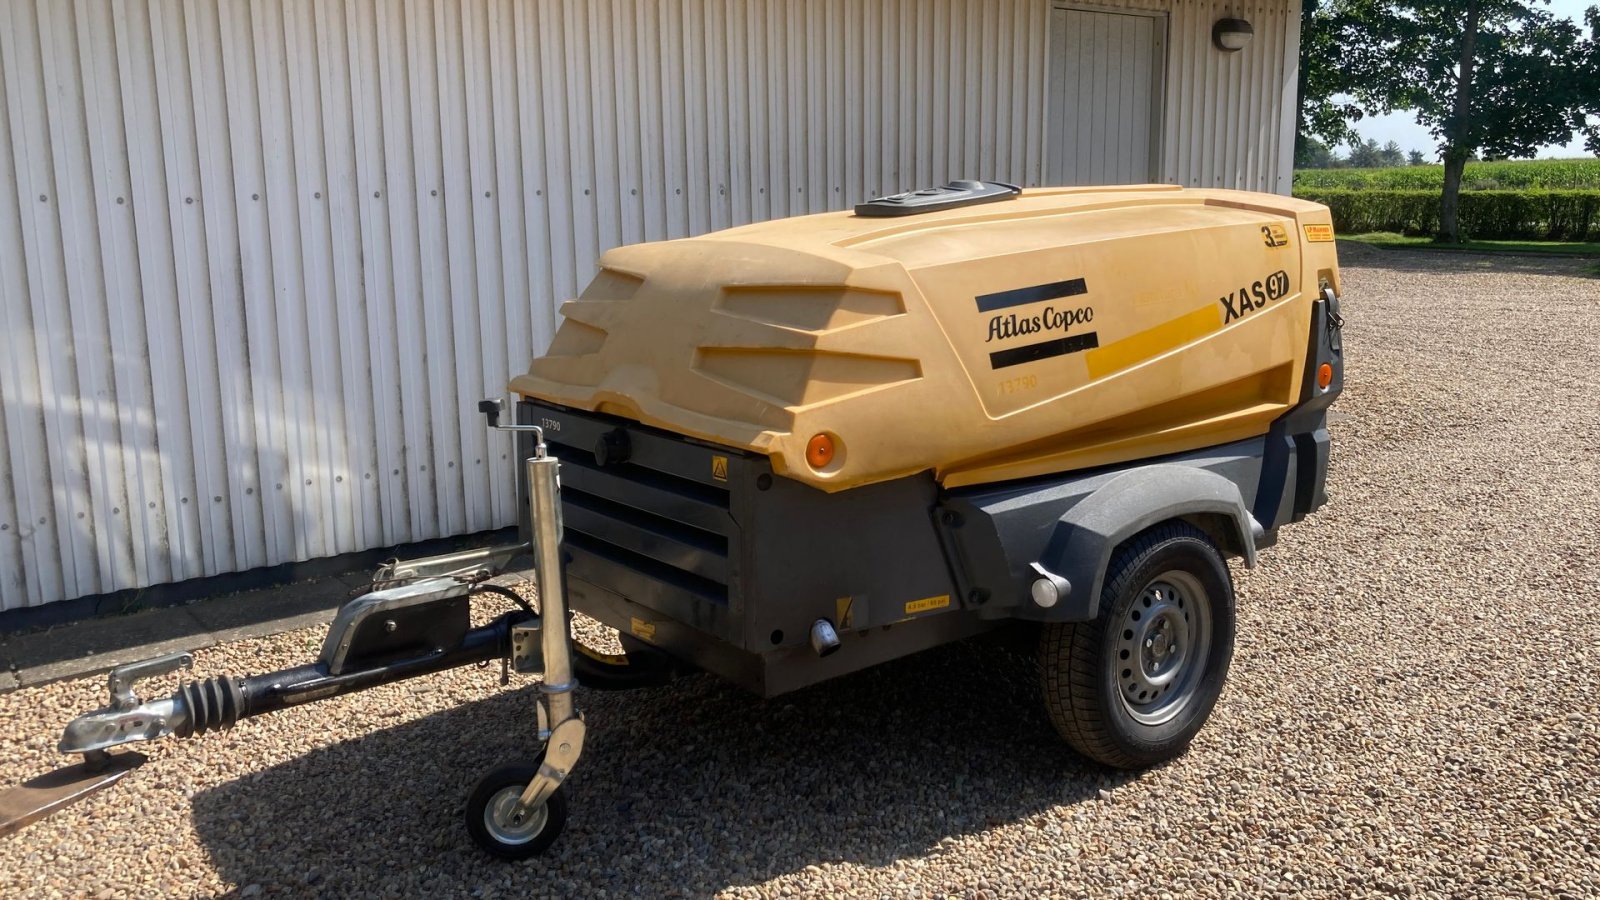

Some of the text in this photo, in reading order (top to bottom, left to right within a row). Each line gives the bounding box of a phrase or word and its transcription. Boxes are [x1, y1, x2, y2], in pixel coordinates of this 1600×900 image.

[1261, 226, 1275, 247] 3
[1220, 281, 1266, 324] XAS
[1268, 271, 1286, 299] 97
[985, 306, 1093, 342] Atlas Copco
[998, 374, 1037, 394] 13790
[542, 418, 560, 431] 13790
